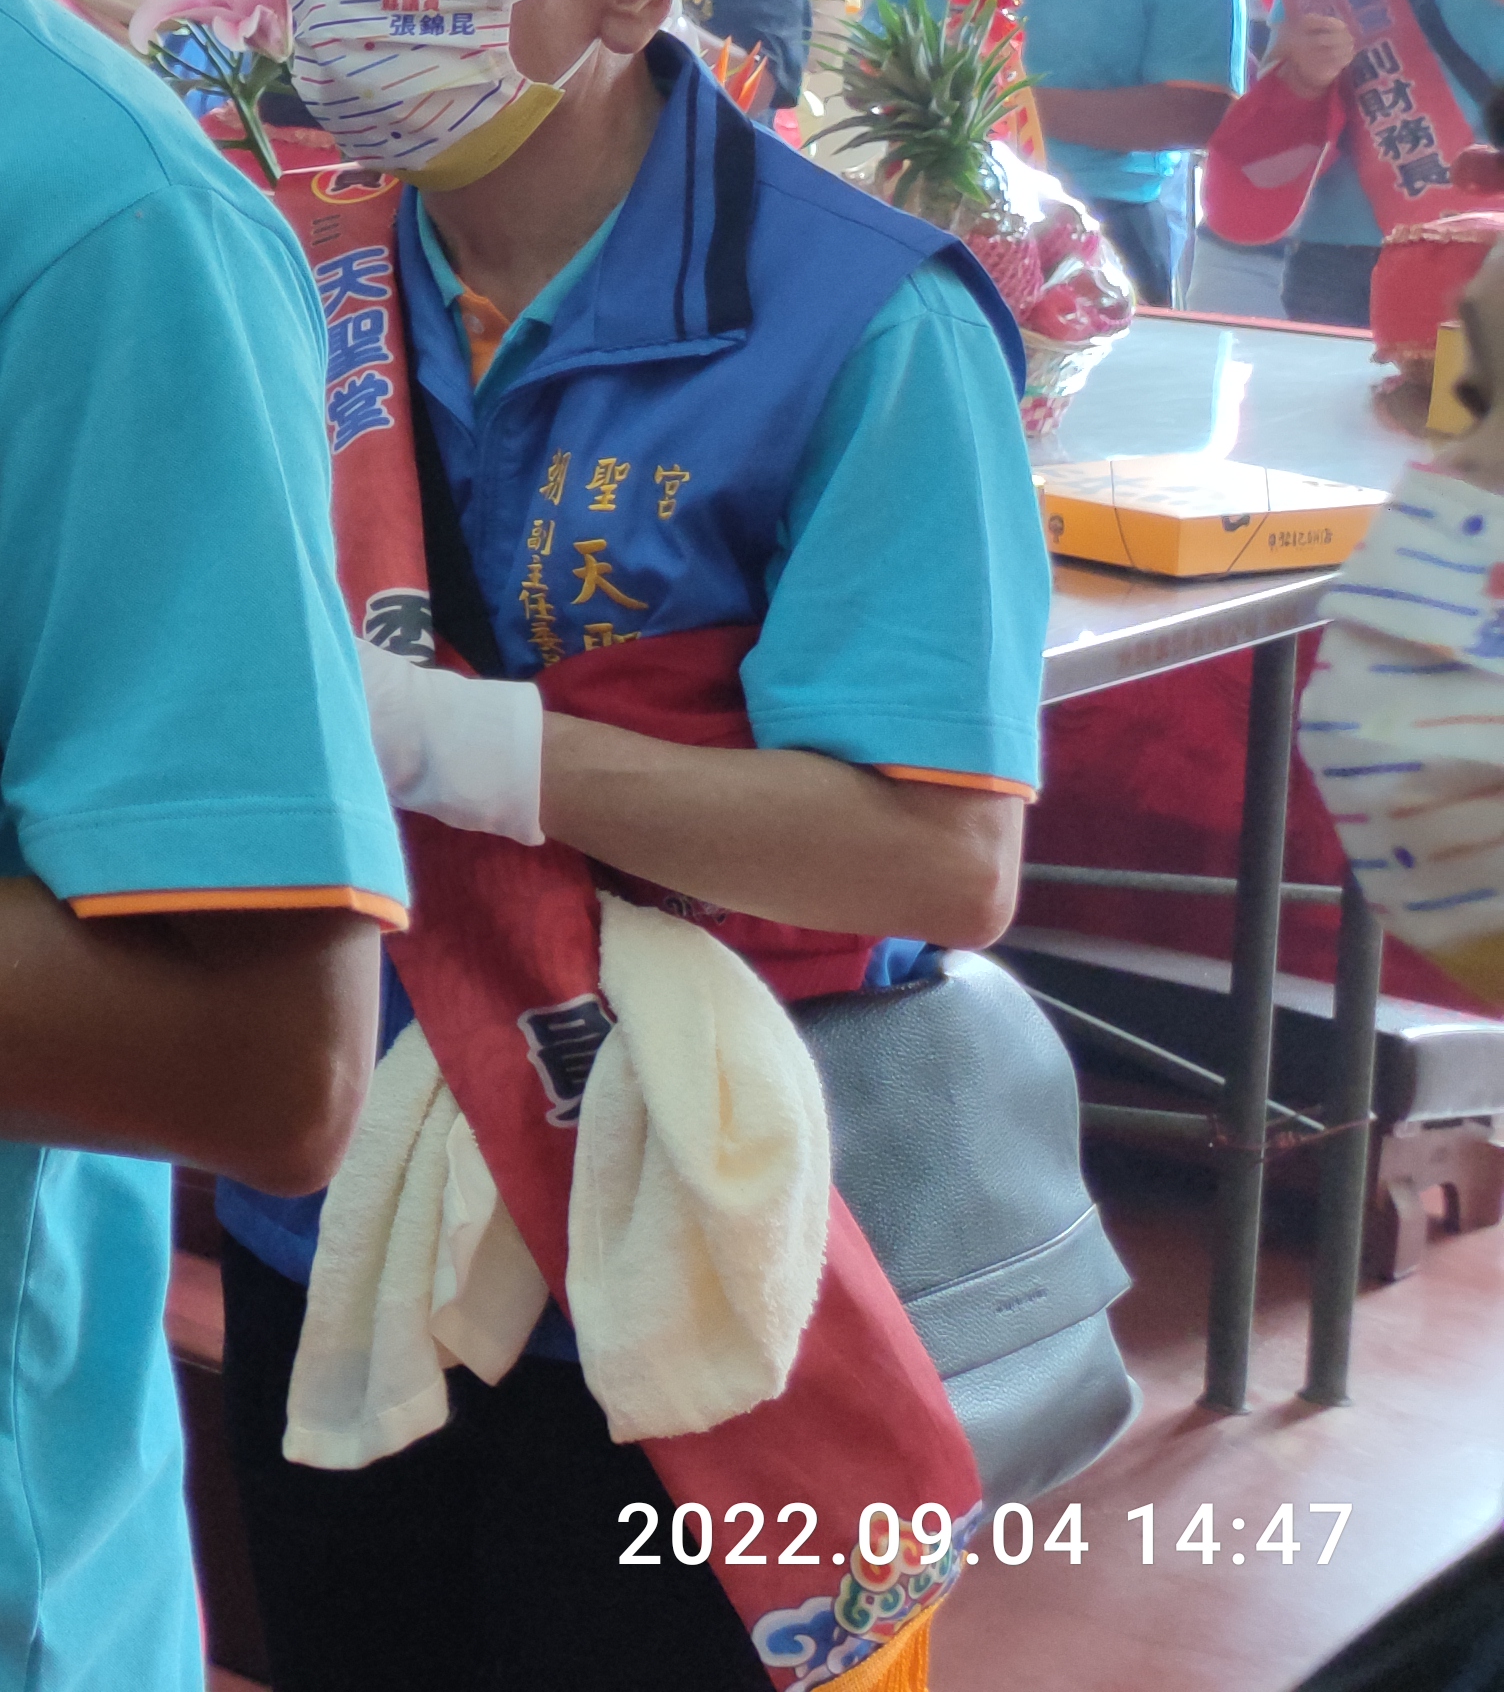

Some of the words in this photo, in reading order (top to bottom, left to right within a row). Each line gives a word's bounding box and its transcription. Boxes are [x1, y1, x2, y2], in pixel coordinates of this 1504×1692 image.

[388, 12, 476, 36] 張錦昆
[317, 245, 395, 455] 天聖堂
[539, 447, 691, 521] 朝聖宮
